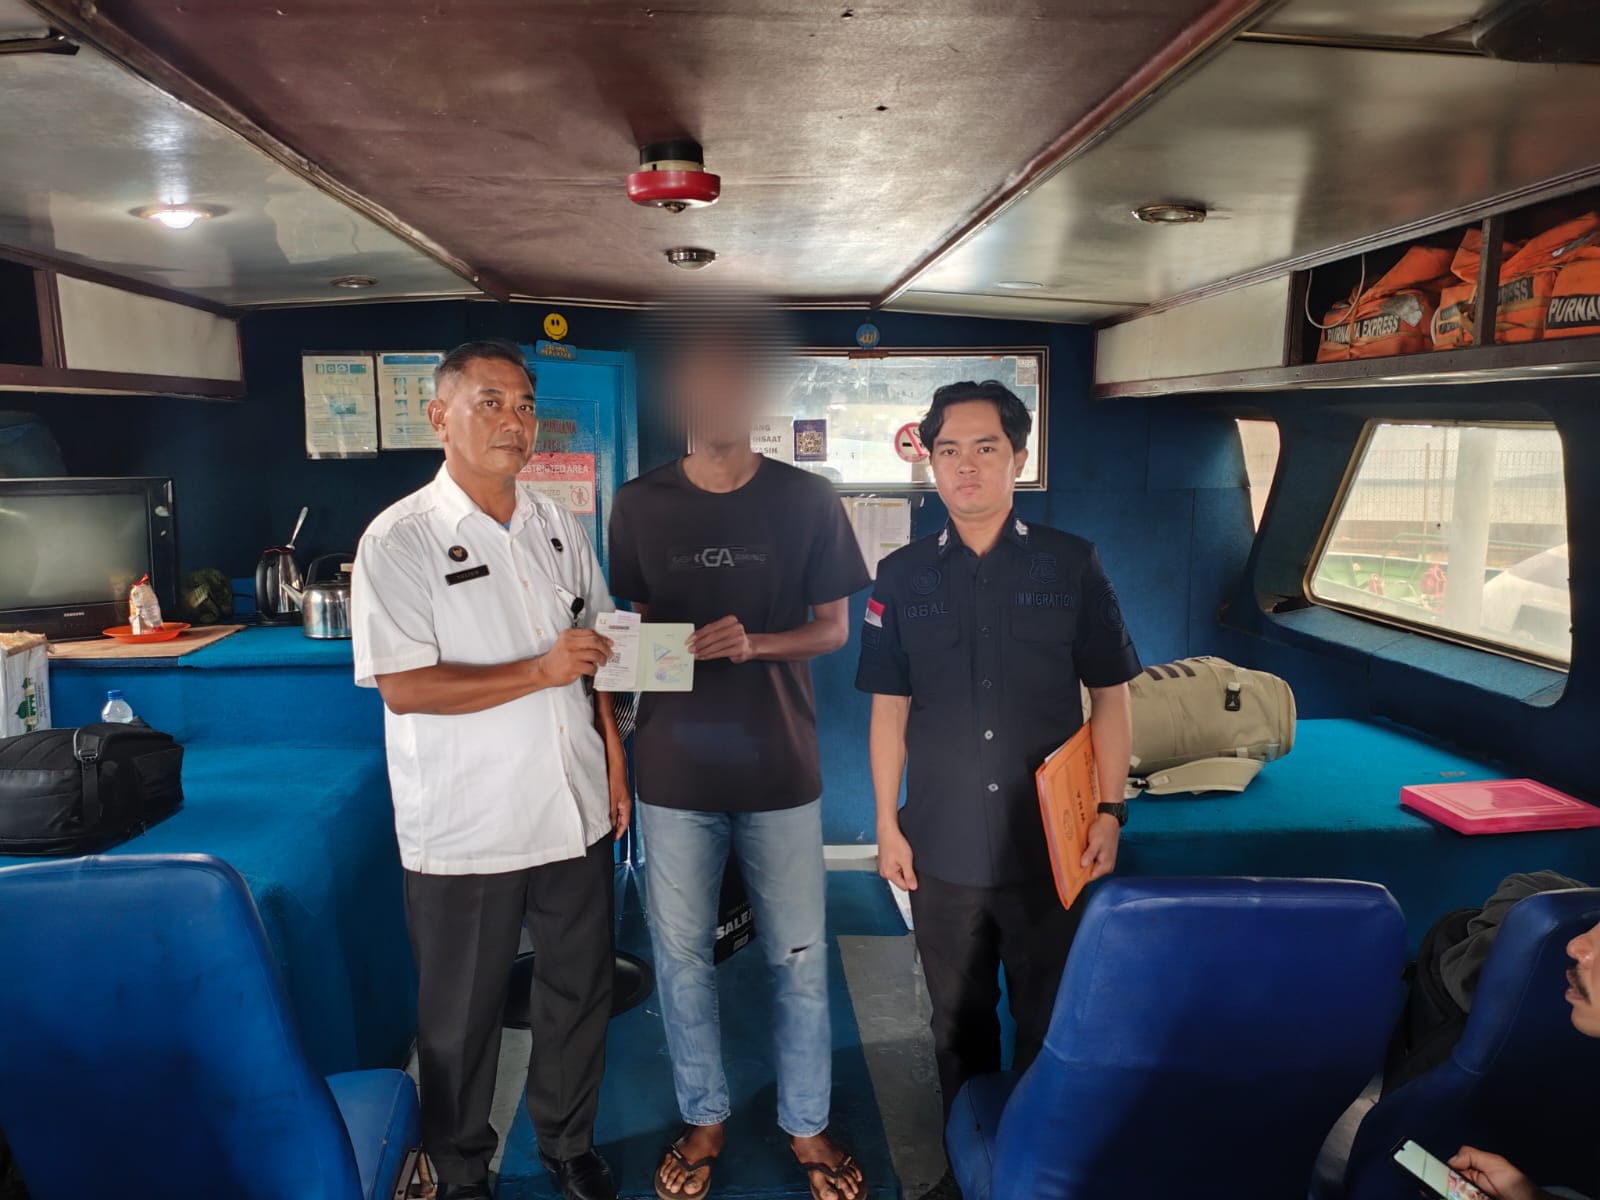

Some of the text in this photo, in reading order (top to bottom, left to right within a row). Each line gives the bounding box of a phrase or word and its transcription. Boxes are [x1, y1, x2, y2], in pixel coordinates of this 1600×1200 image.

[1362, 315, 1399, 337] EXPRESS
[519, 464, 589, 473] ESTRICTED AREA
